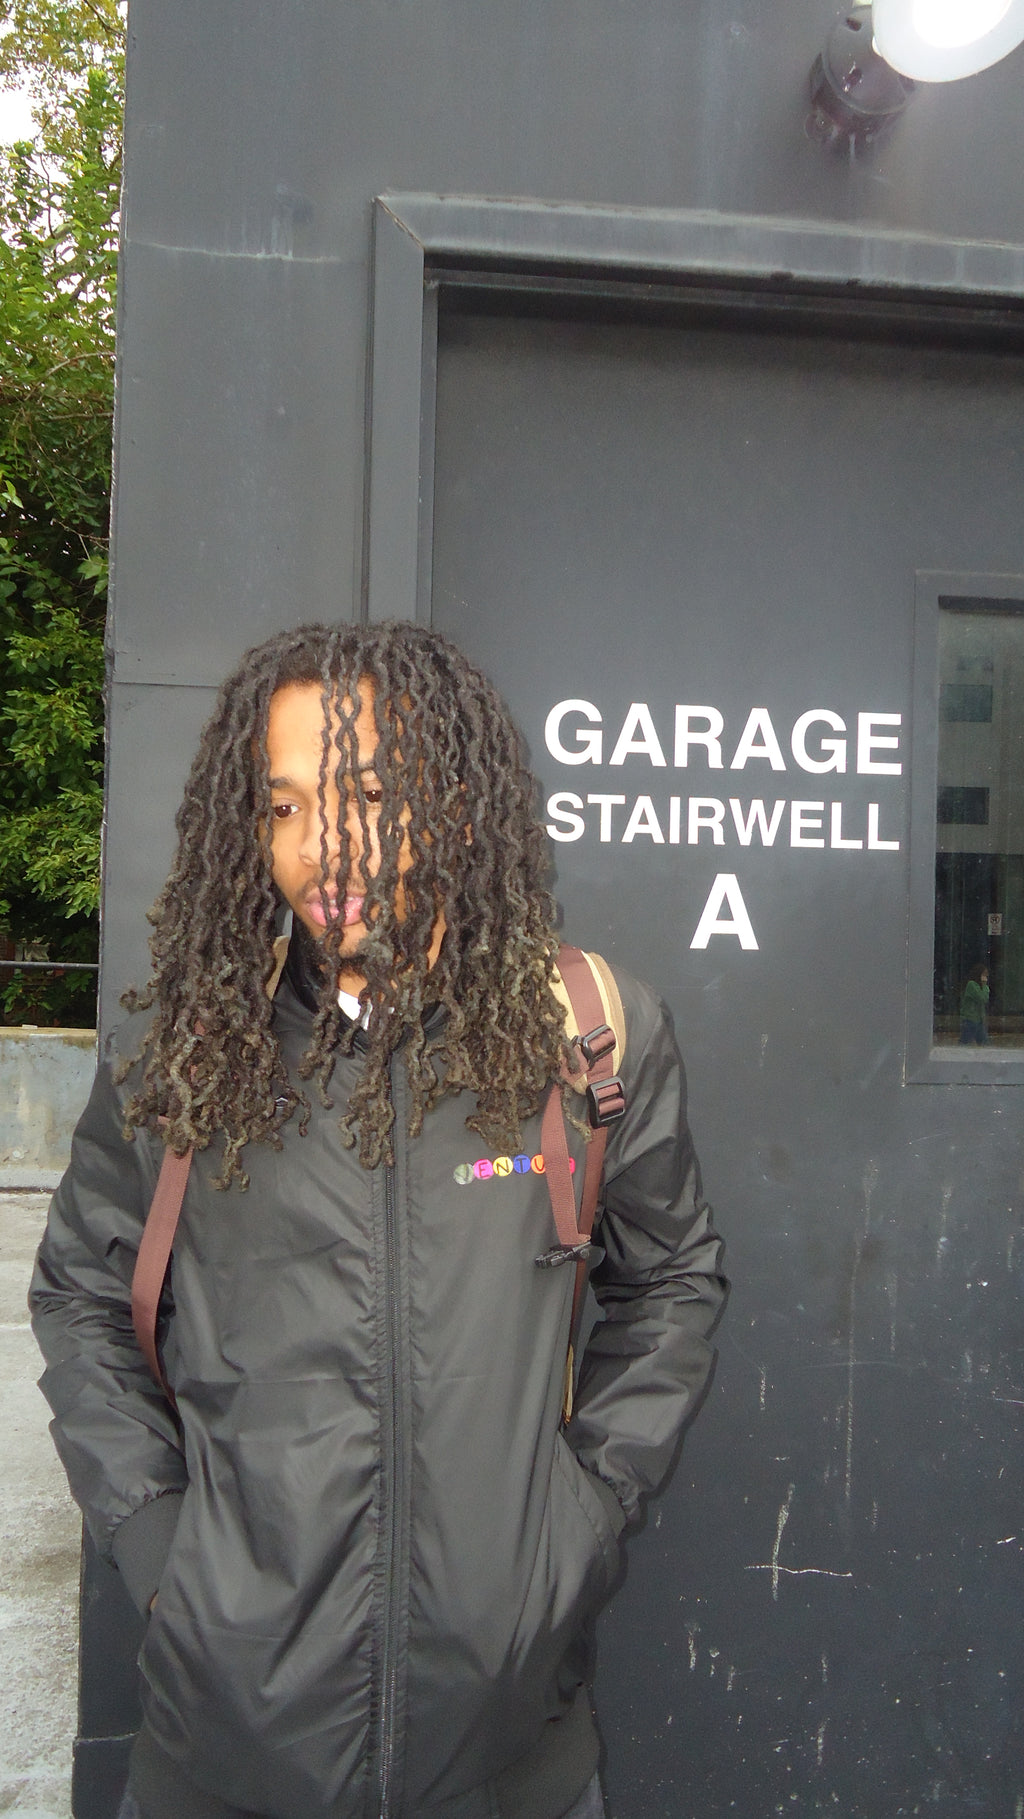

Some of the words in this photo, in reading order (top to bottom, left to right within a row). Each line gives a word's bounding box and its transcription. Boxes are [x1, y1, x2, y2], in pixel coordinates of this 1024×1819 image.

[545, 699, 902, 776] GARAGE
[546, 792, 900, 851] STAIRWELL
[690, 873, 759, 950] A
